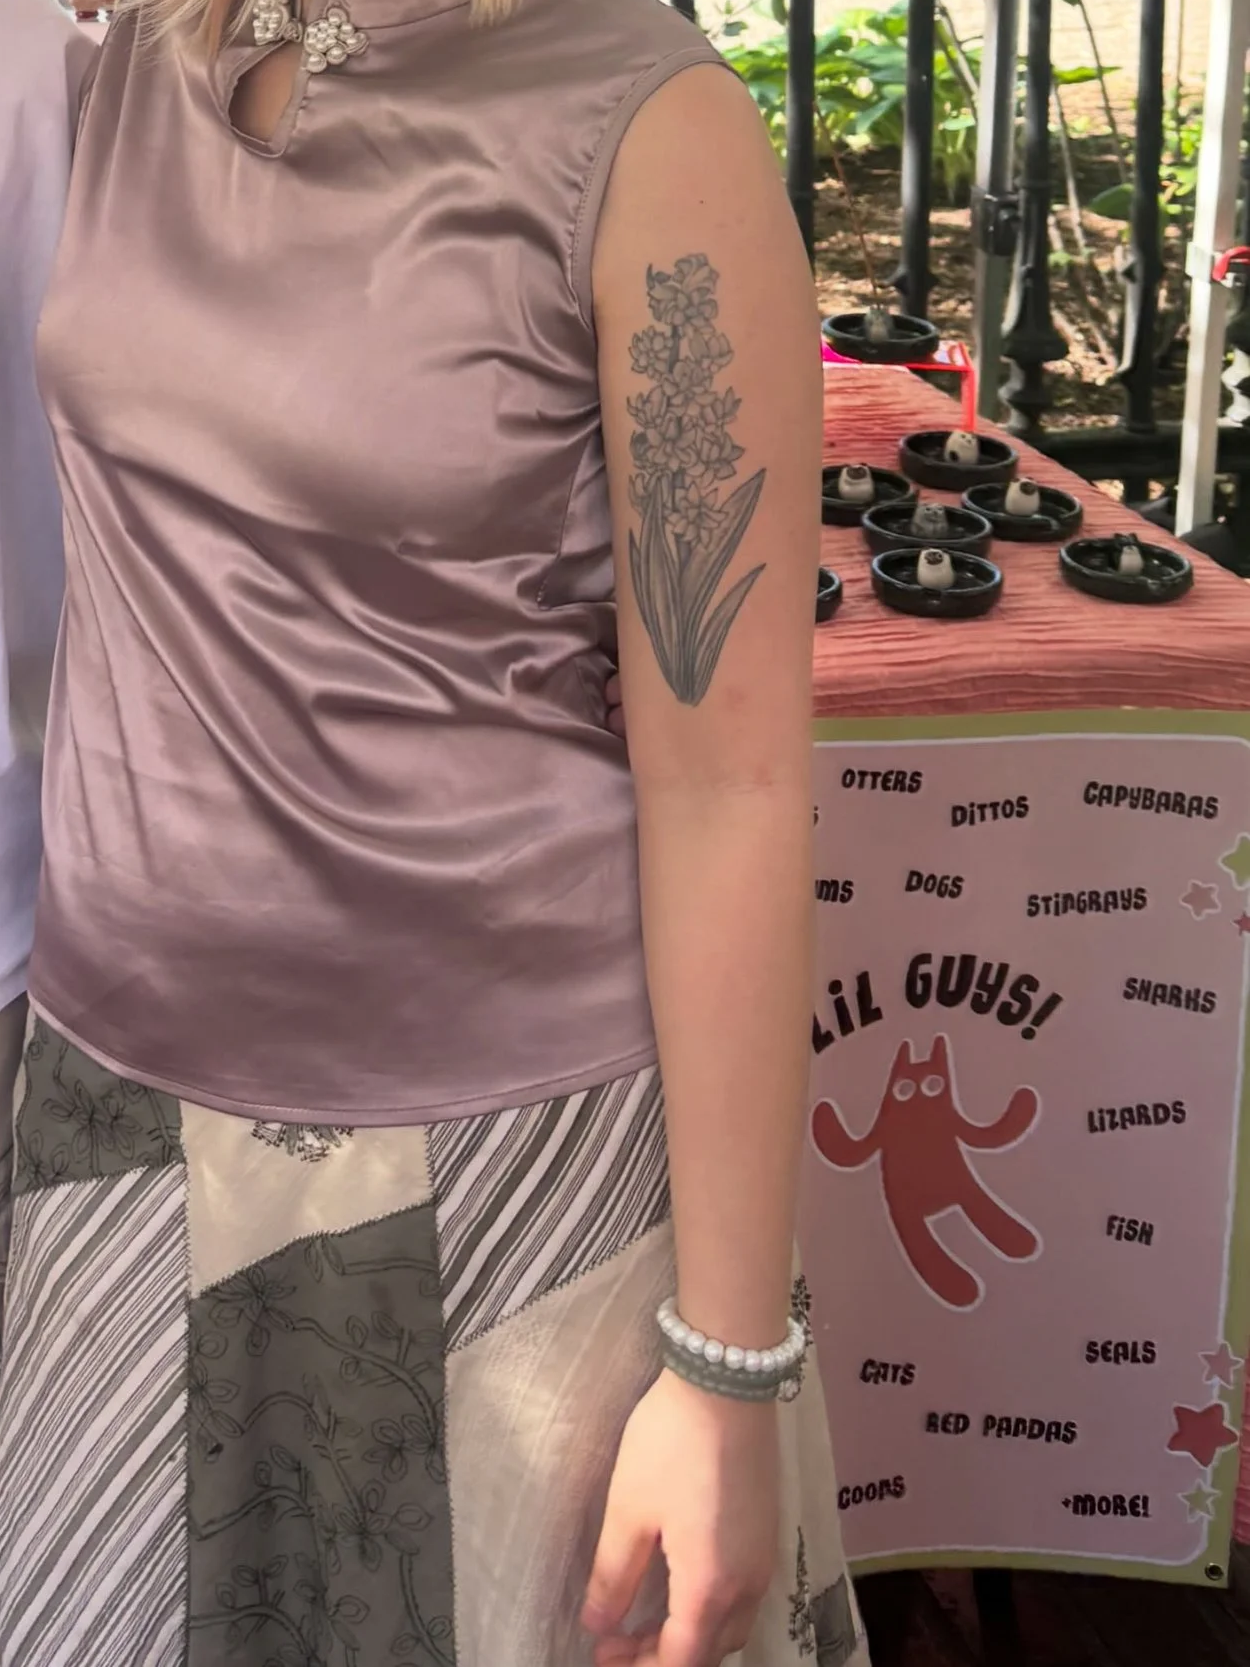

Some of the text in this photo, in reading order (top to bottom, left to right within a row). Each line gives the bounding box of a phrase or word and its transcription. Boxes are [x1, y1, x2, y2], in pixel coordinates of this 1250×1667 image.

[841, 768, 923, 793] OTTERS
[1083, 781, 1219, 819] CAPYBARAS
[905, 870, 964, 899] DOGS
[905, 953, 1064, 1041] GUYS!
[1123, 977, 1217, 1014] SHARKS
[1085, 1340, 1157, 1365] SEALS
[860, 1359, 916, 1385] CATS
[925, 1412, 970, 1434] RED
